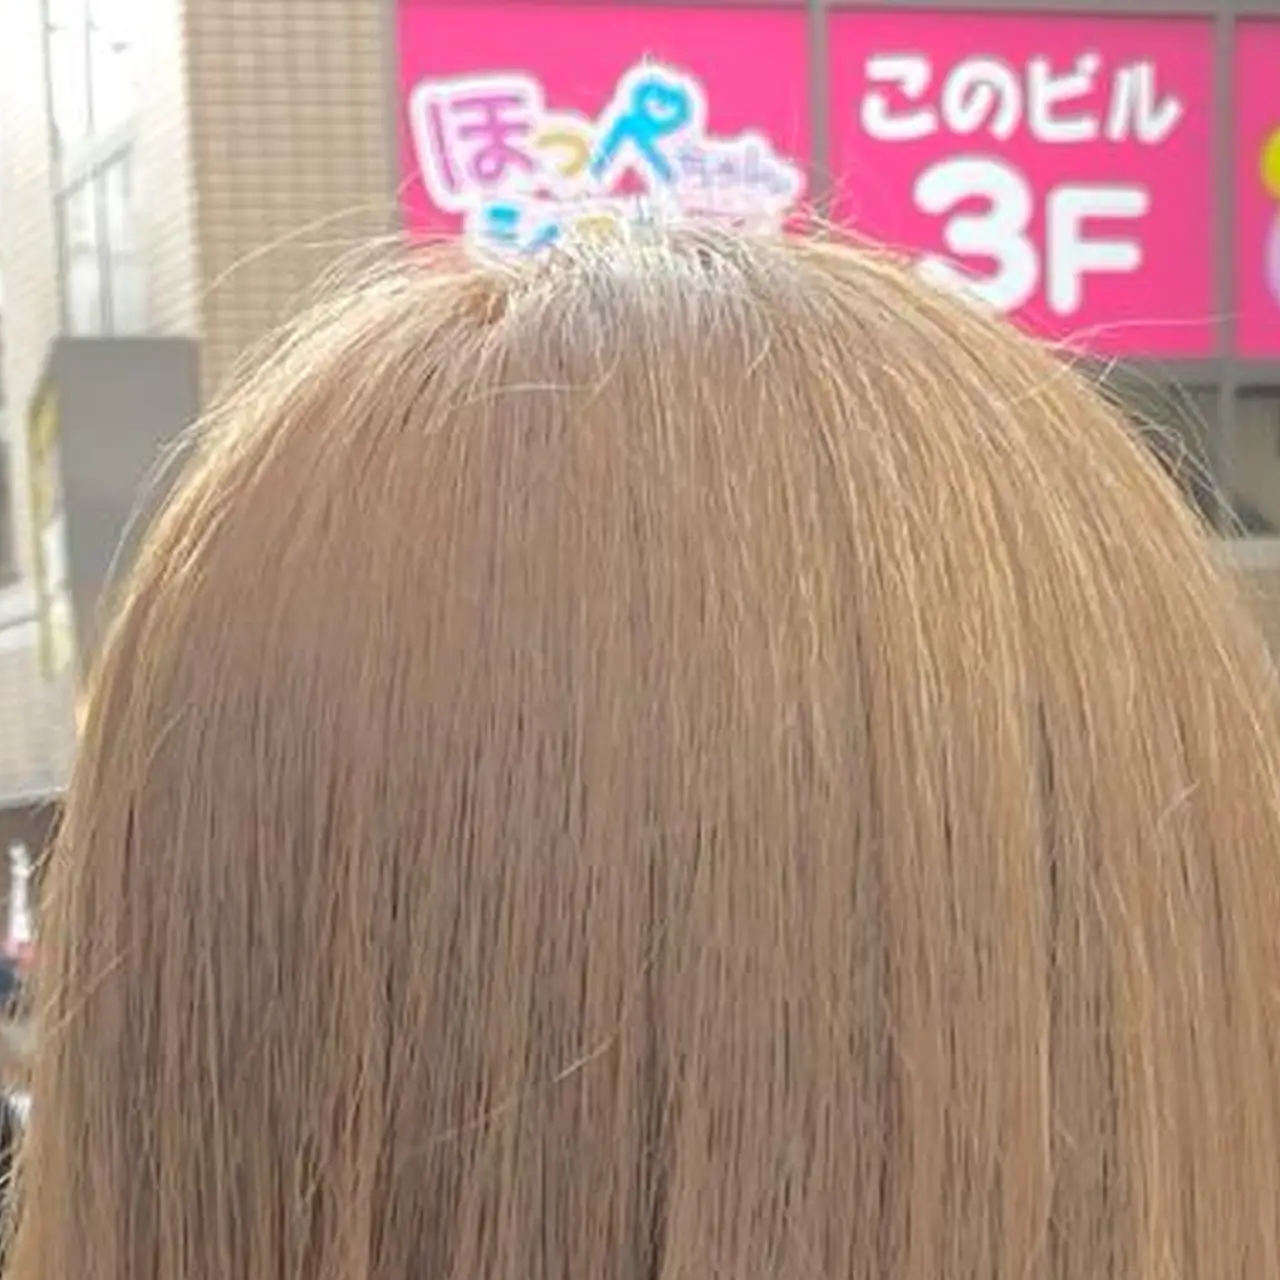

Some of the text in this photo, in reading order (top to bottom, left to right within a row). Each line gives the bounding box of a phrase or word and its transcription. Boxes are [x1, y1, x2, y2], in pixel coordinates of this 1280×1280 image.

[860, 51, 1183, 143] このビル
[912, 155, 1151, 316] 3F
